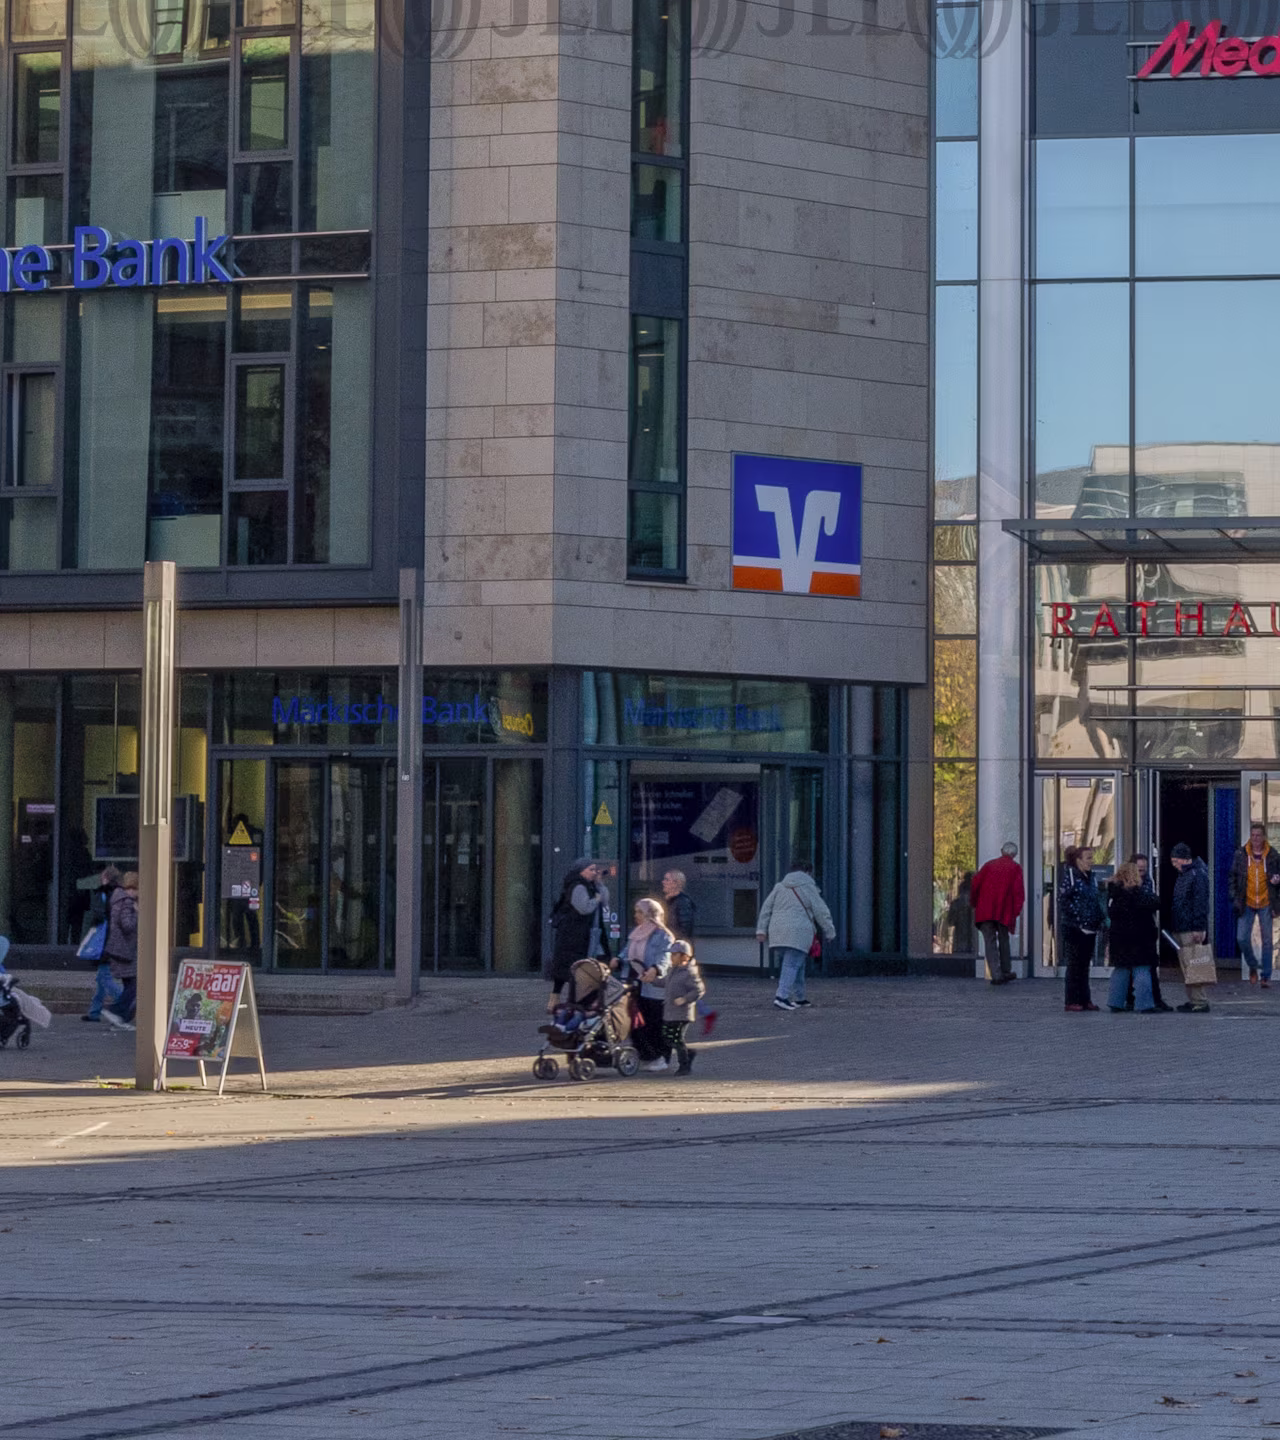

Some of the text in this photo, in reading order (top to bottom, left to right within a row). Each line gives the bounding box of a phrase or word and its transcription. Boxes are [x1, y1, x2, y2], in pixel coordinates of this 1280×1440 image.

[72, 215, 236, 290] Bank
[272, 695, 399, 725] Märkisch
[422, 694, 491, 725] Bank
[183, 965, 240, 992] Bazaar
